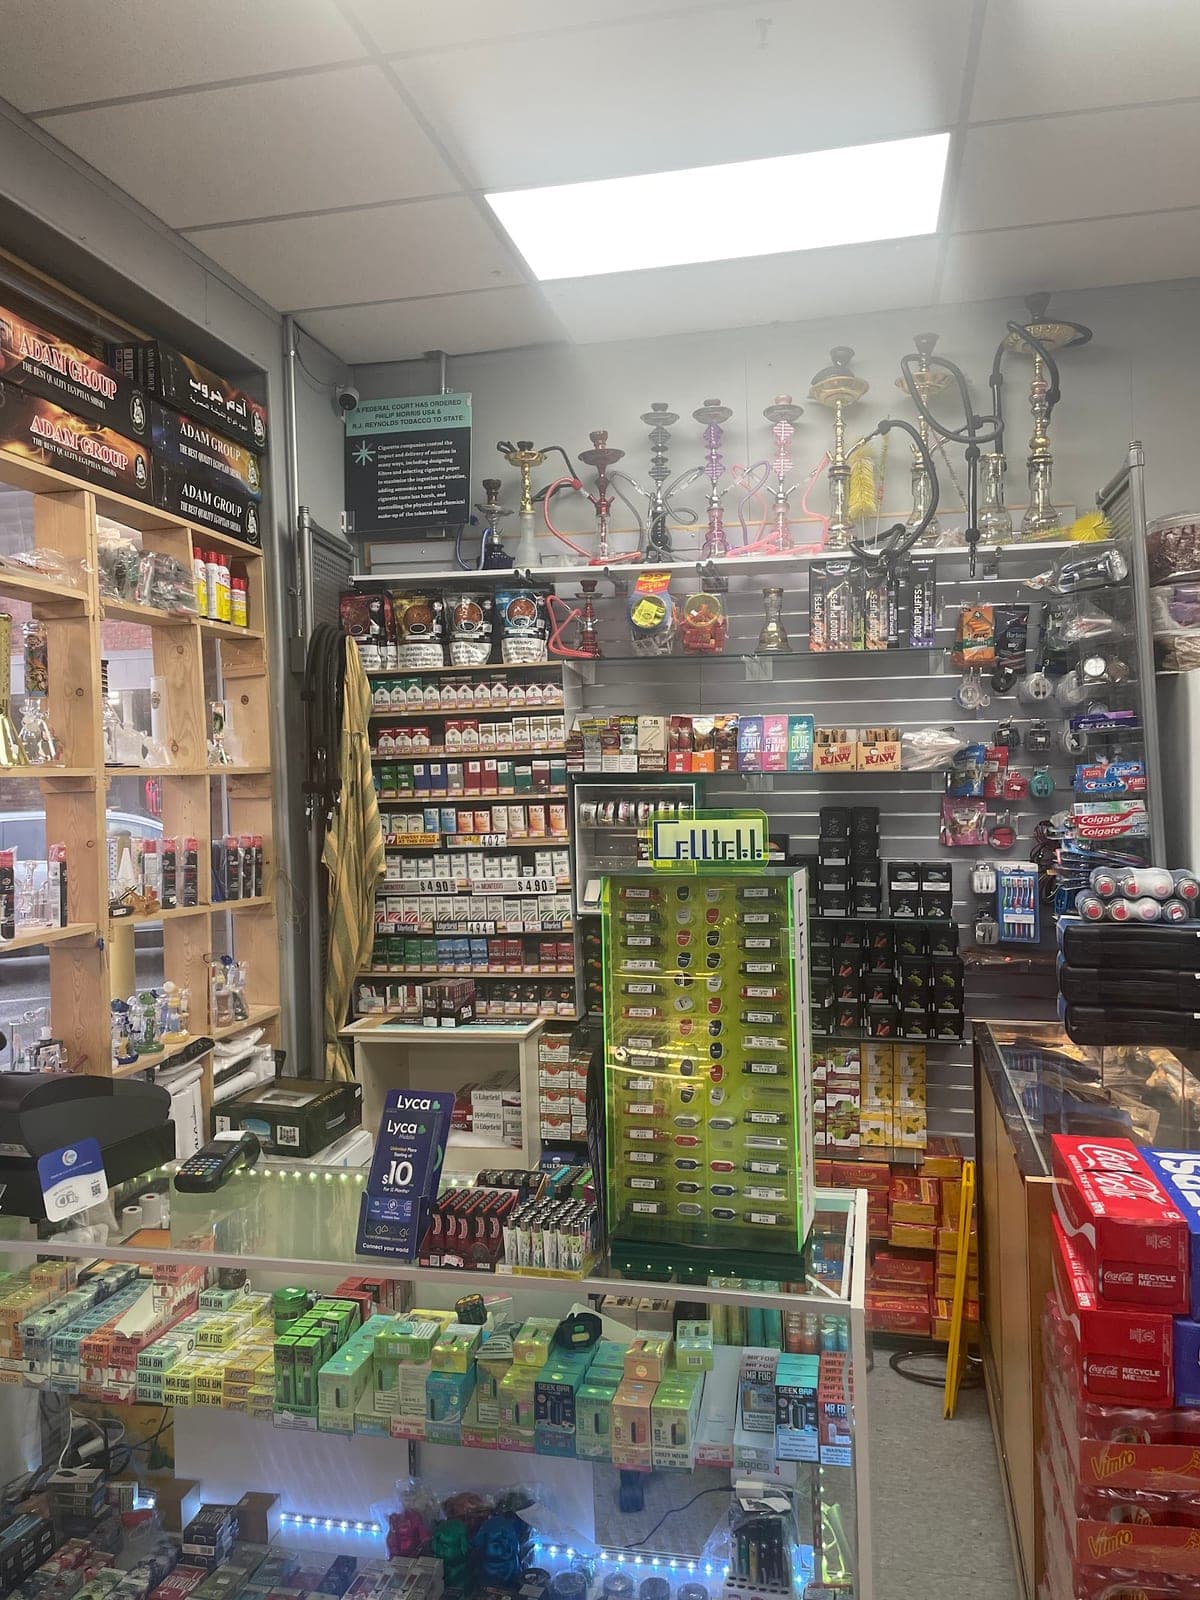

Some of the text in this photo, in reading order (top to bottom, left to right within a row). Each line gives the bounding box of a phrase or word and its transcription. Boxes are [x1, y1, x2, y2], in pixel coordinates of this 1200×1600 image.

[20, 335, 117, 400] ADAM GROUP
[22, 361, 32, 373] THE
[33, 366, 47, 380] BEST
[47, 373, 66, 389] QUALITY
[392, 403, 414, 411] COURT
[430, 399, 462, 407] ORDERED
[396, 410, 421, 418] MORRIS
[364, 420, 399, 429] REYNOLDS
[401, 417, 431, 425] TOBACCO
[30, 415, 128, 470] ADAM GROUP
[180, 422, 241, 461] ADAM GROUP
[181, 483, 242, 518] ADAM GROUP
[791, 735, 810, 749] BLUE
[820, 752, 851, 766] RAW
[865, 751, 896, 765] RAW
[1086, 781, 1116, 789] Crest
[1081, 816, 1120, 825] Colgate
[1081, 827, 1121, 837] Colgate
[397, 1095, 431, 1111] Lyca
[387, 1119, 418, 1136] Lyca
[362, 1242, 383, 1251] Connect
[156, 1264, 177, 1273] MR FOG
[1138, 1273, 1177, 1283] RECYCLE
[199, 1332, 223, 1344] MR FOG
[138, 1356, 163, 1368] MR FOG
[745, 1370, 772, 1381] MR FOG
[1122, 1367, 1161, 1377] RECYCLE
[165, 1377, 190, 1388] MR FOG
[538, 1383, 556, 1392] GEEK
[779, 1386, 798, 1394] GEEK
[164, 1394, 189, 1405] MR FOG
[824, 1403, 835, 1414] MR
